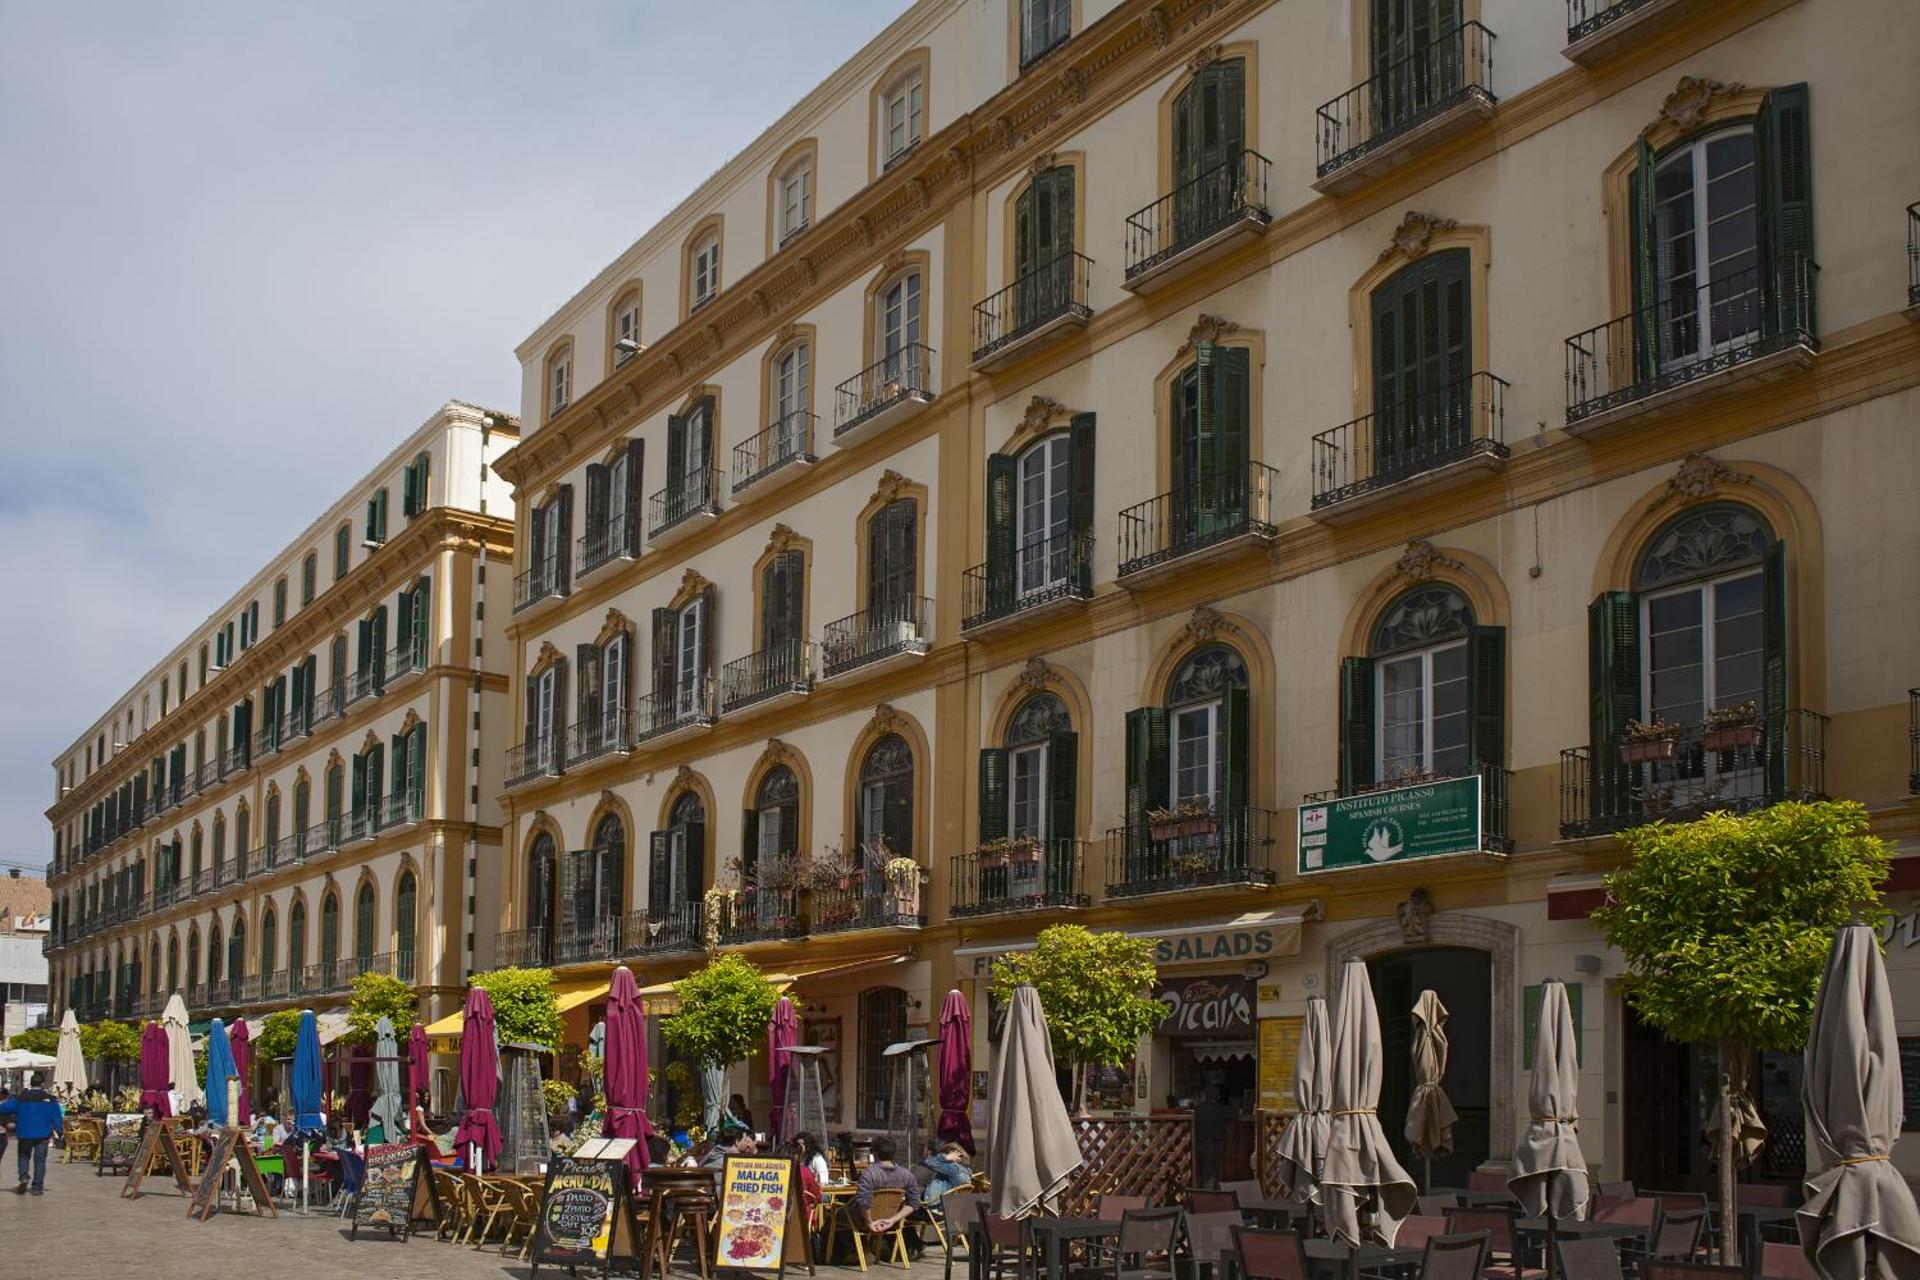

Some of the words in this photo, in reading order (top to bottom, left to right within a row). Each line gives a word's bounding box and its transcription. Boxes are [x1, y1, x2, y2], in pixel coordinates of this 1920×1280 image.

[1336, 795, 1389, 812] INSTITUTO
[1390, 788, 1435, 804] PICASSO
[1350, 807, 1382, 820] SPANISH
[1383, 803, 1421, 815] COURSES
[1156, 930, 1273, 961] SALADS
[548, 1174, 585, 1193] MENU
[737, 1170, 779, 1181] MALAGA
[731, 1182, 760, 1193] FRIED
[761, 1183, 783, 1194] FISH
